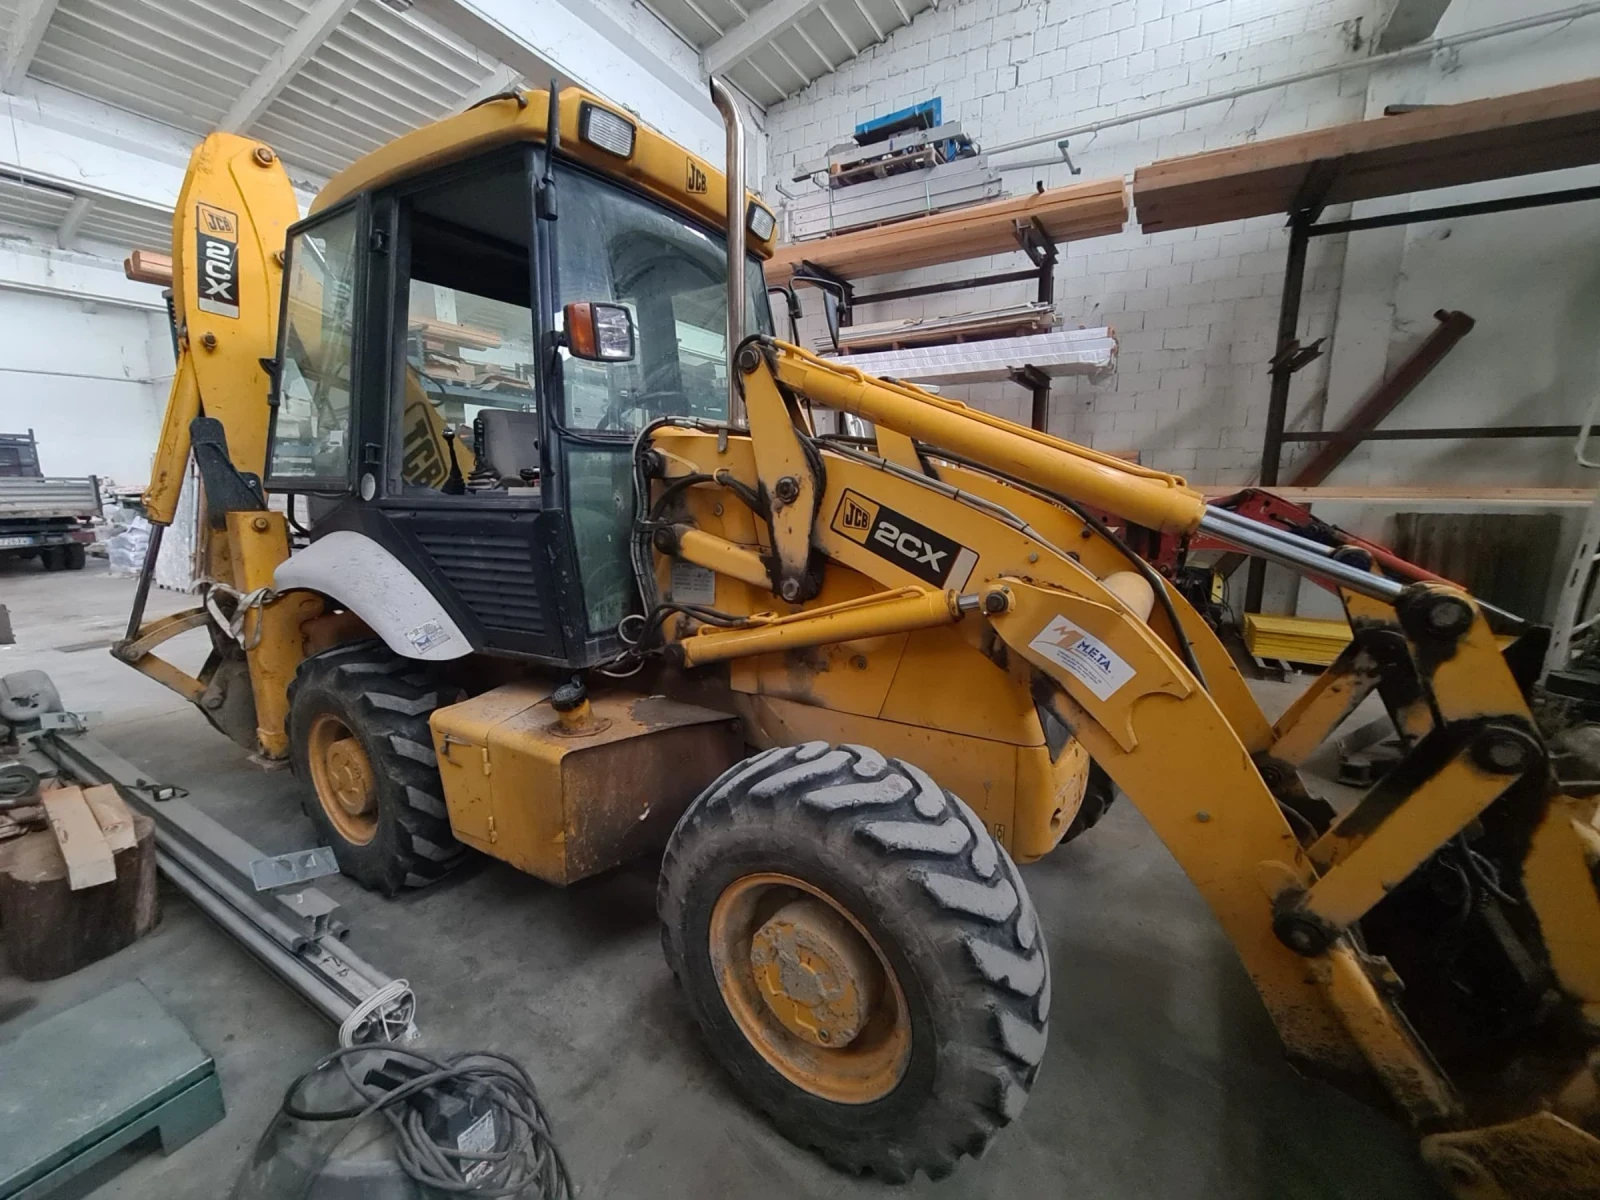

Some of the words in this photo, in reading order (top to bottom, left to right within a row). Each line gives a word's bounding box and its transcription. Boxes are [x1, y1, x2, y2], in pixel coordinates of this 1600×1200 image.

[688, 163, 707, 192] JCB
[208, 213, 234, 232] JCB
[205, 240, 234, 301] 2CX
[845, 502, 869, 529] JCB
[873, 521, 948, 573] 2CX
